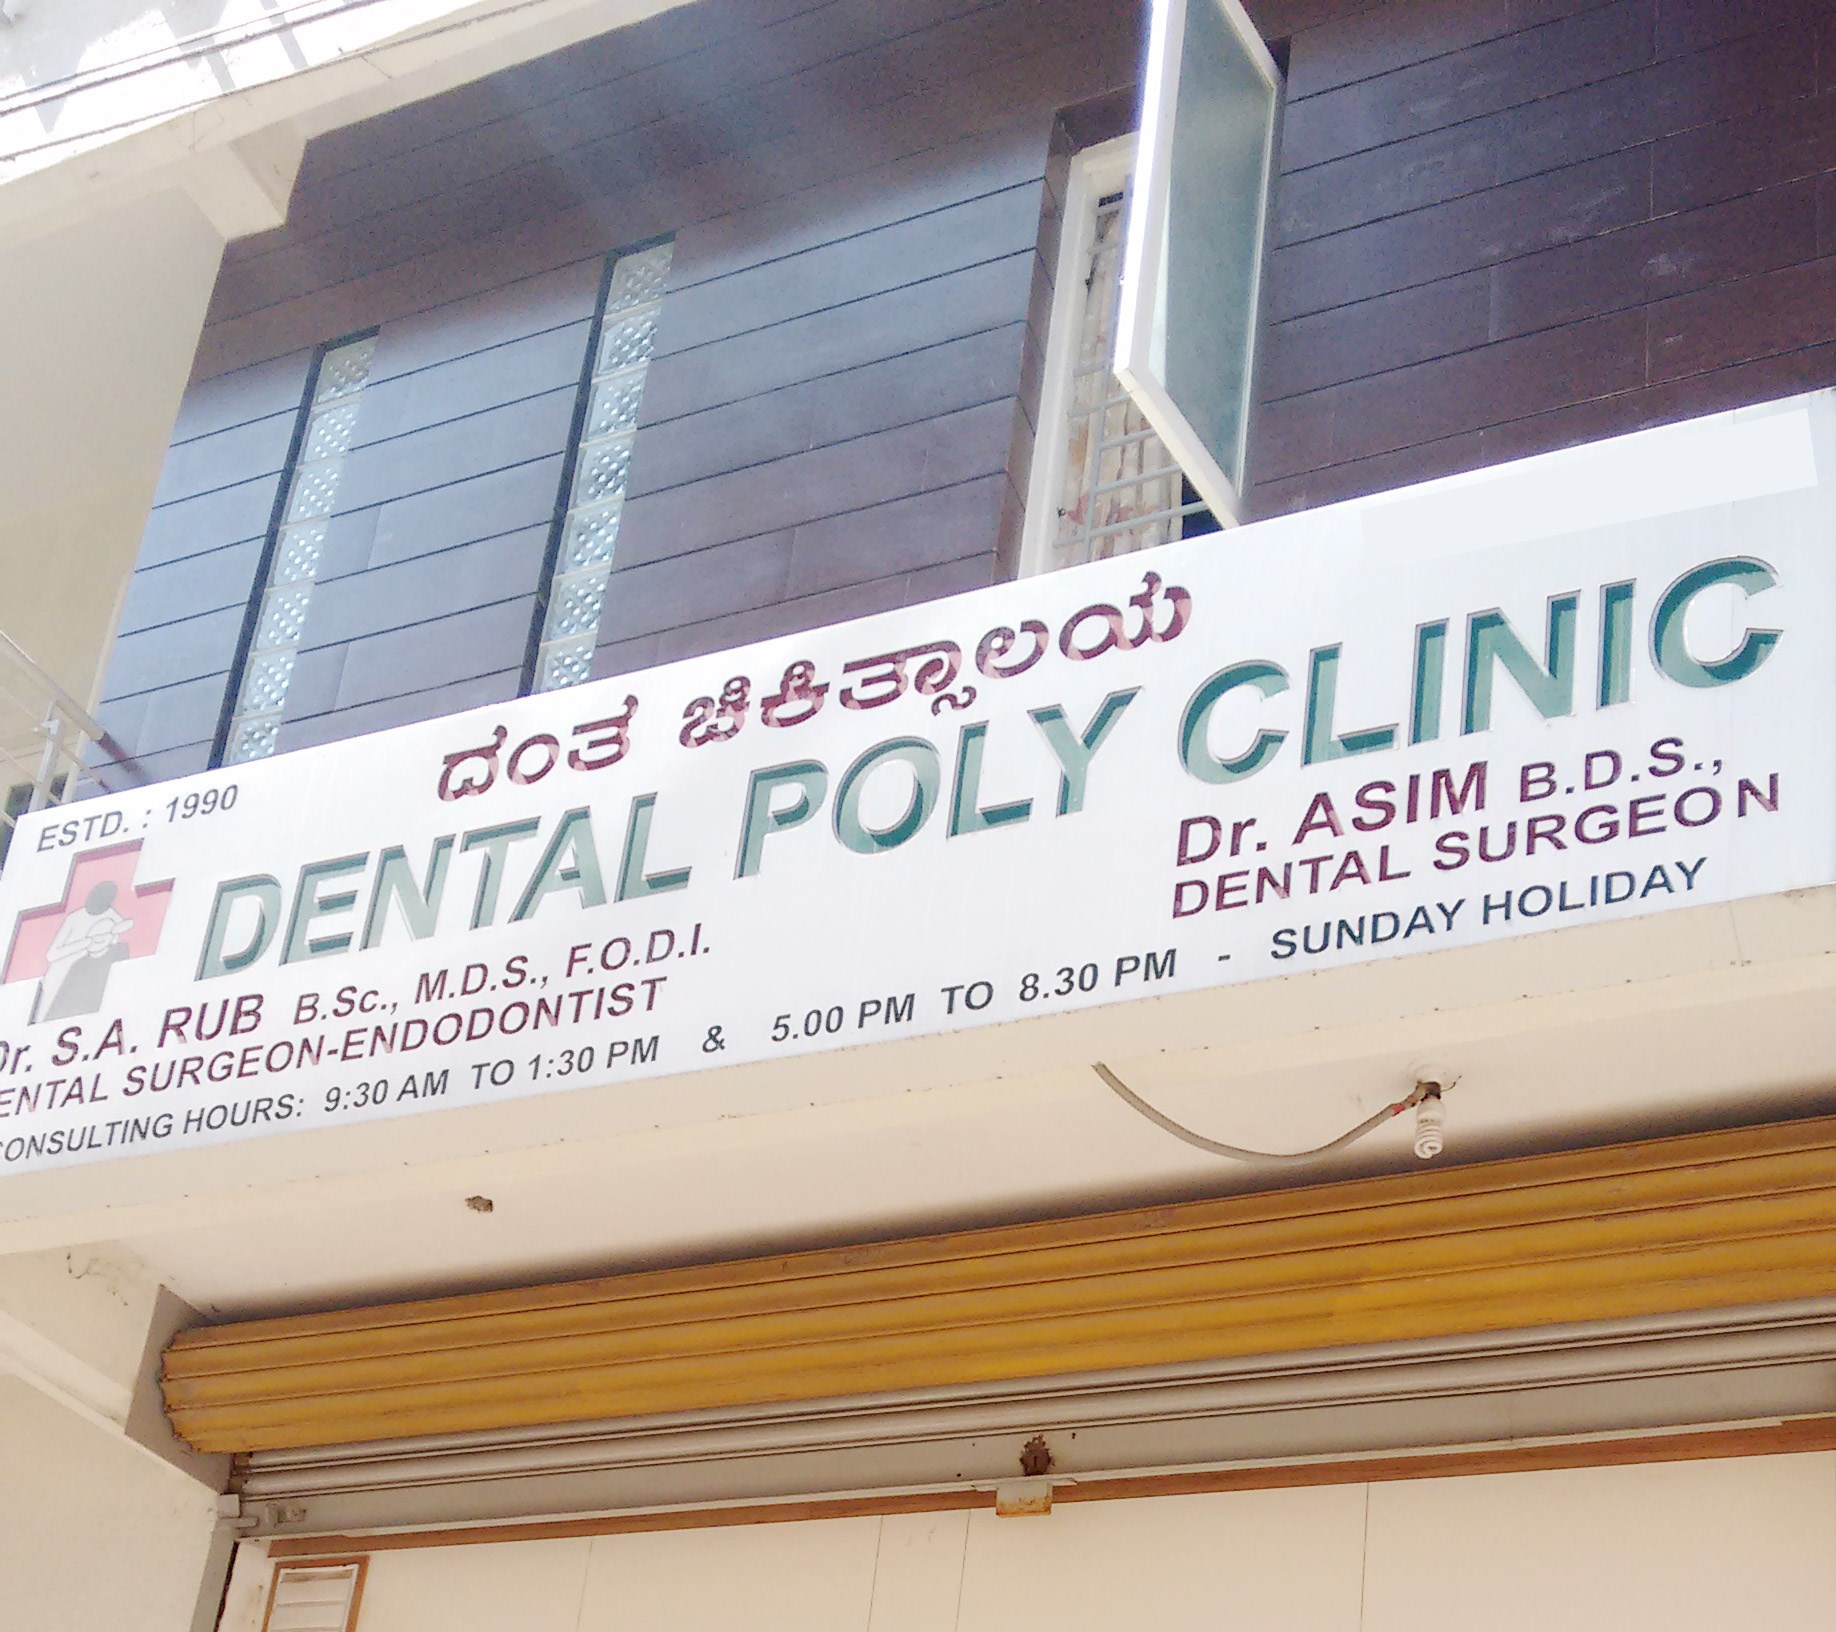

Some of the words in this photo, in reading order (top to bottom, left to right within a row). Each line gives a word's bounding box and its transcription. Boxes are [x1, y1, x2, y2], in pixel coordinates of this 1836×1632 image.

[36, 811, 129, 852] ESTD.
[165, 784, 239, 824] 1990
[194, 792, 692, 982] DENTAL
[733, 686, 1145, 880] POLY
[1177, 555, 1785, 785] CLINIC
[437, 694, 639, 802] ದಂತ
[1175, 814, 1267, 867] Dr.
[1293, 760, 1487, 846] ASIM
[1518, 736, 1723, 803] B.D.S.,
[1172, 844, 1411, 918] DENTAL
[1433, 773, 1780, 872] SURGEON
[0, 1113, 173, 1162] ONSULTING
[183, 1096, 304, 1134] HOURS:
[323, 1081, 388, 1113] 9:30
[397, 1069, 450, 1101] AM
[471, 1057, 514, 1090] TO
[527, 1049, 595, 1082] 1:30
[606, 1036, 660, 1068] PM
[702, 1026, 726, 1053] &
[771, 1005, 844, 1043] 5.00
[857, 993, 916, 1030] PM
[940, 981, 994, 1015] TO
[1018, 962, 1100, 1002] 8.30
[1113, 948, 1177, 986] PM
[1270, 897, 1466, 960] SUNDAY
[1482, 857, 1708, 925] HOLIDAY
[0, 1072, 108, 1118] ENTAL
[123, 976, 667, 1097] SURGEON-ENDODONTIST
[52, 1018, 137, 1067] S.A.
[157, 993, 264, 1048] RUB
[413, 955, 549, 1006] M.D.S.,
[565, 923, 711, 978] F.O.D.I.
